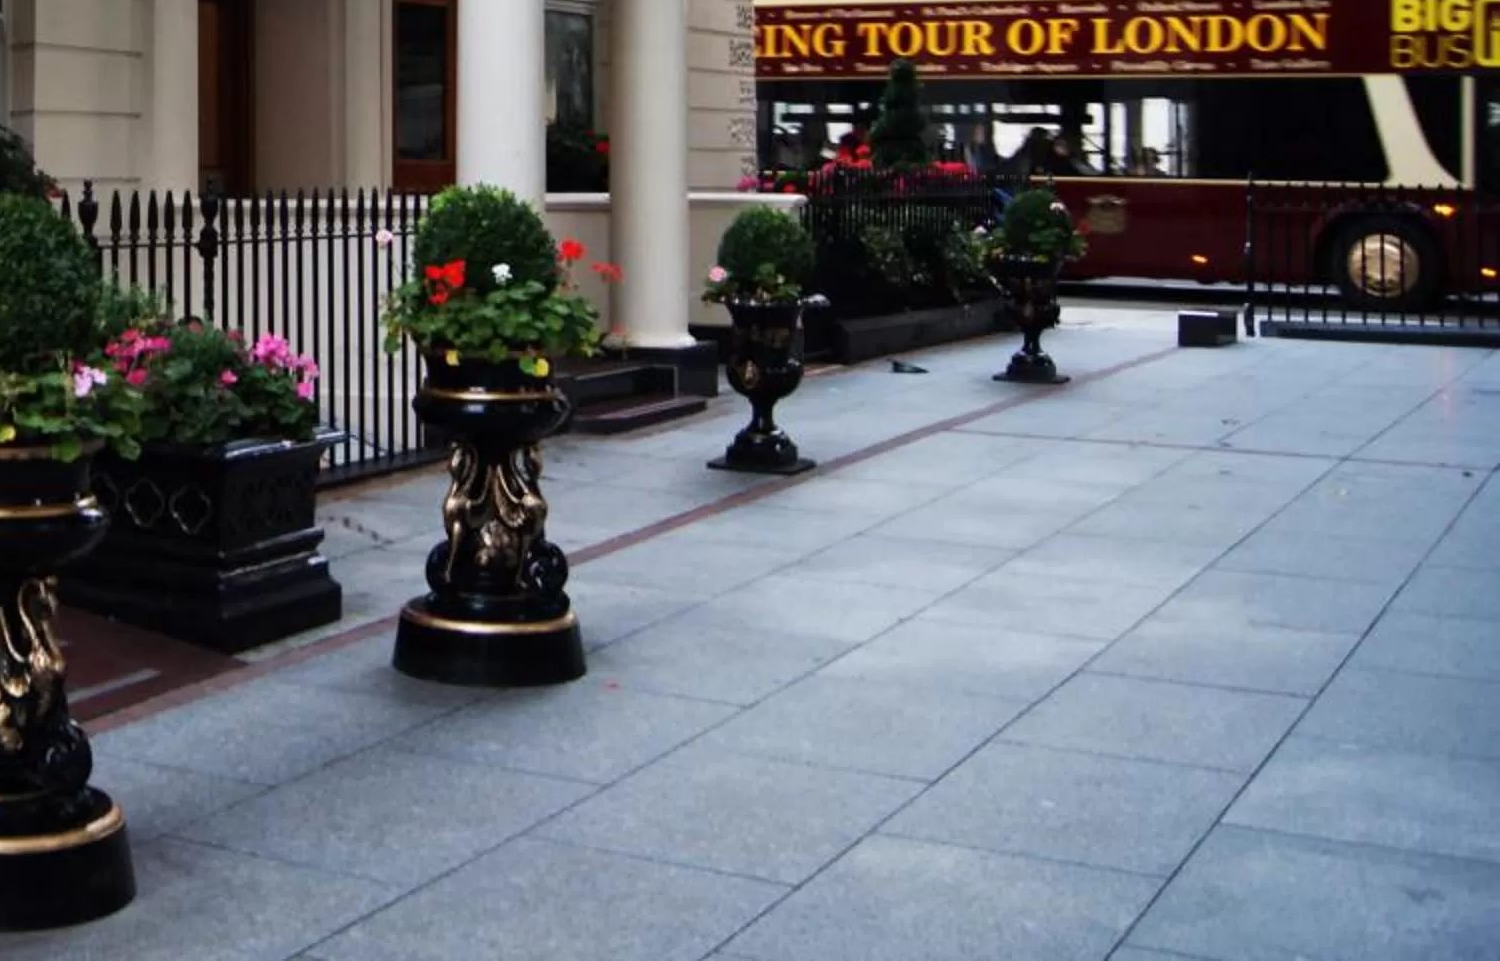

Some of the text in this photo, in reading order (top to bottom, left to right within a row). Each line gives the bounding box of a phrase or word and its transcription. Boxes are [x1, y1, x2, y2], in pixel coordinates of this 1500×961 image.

[754, 21, 847, 58] ING
[855, 20, 997, 57] TOUR
[1005, 18, 1080, 57] OF
[1090, 13, 1331, 55] LONDON
[1390, 34, 1473, 69] BUS
